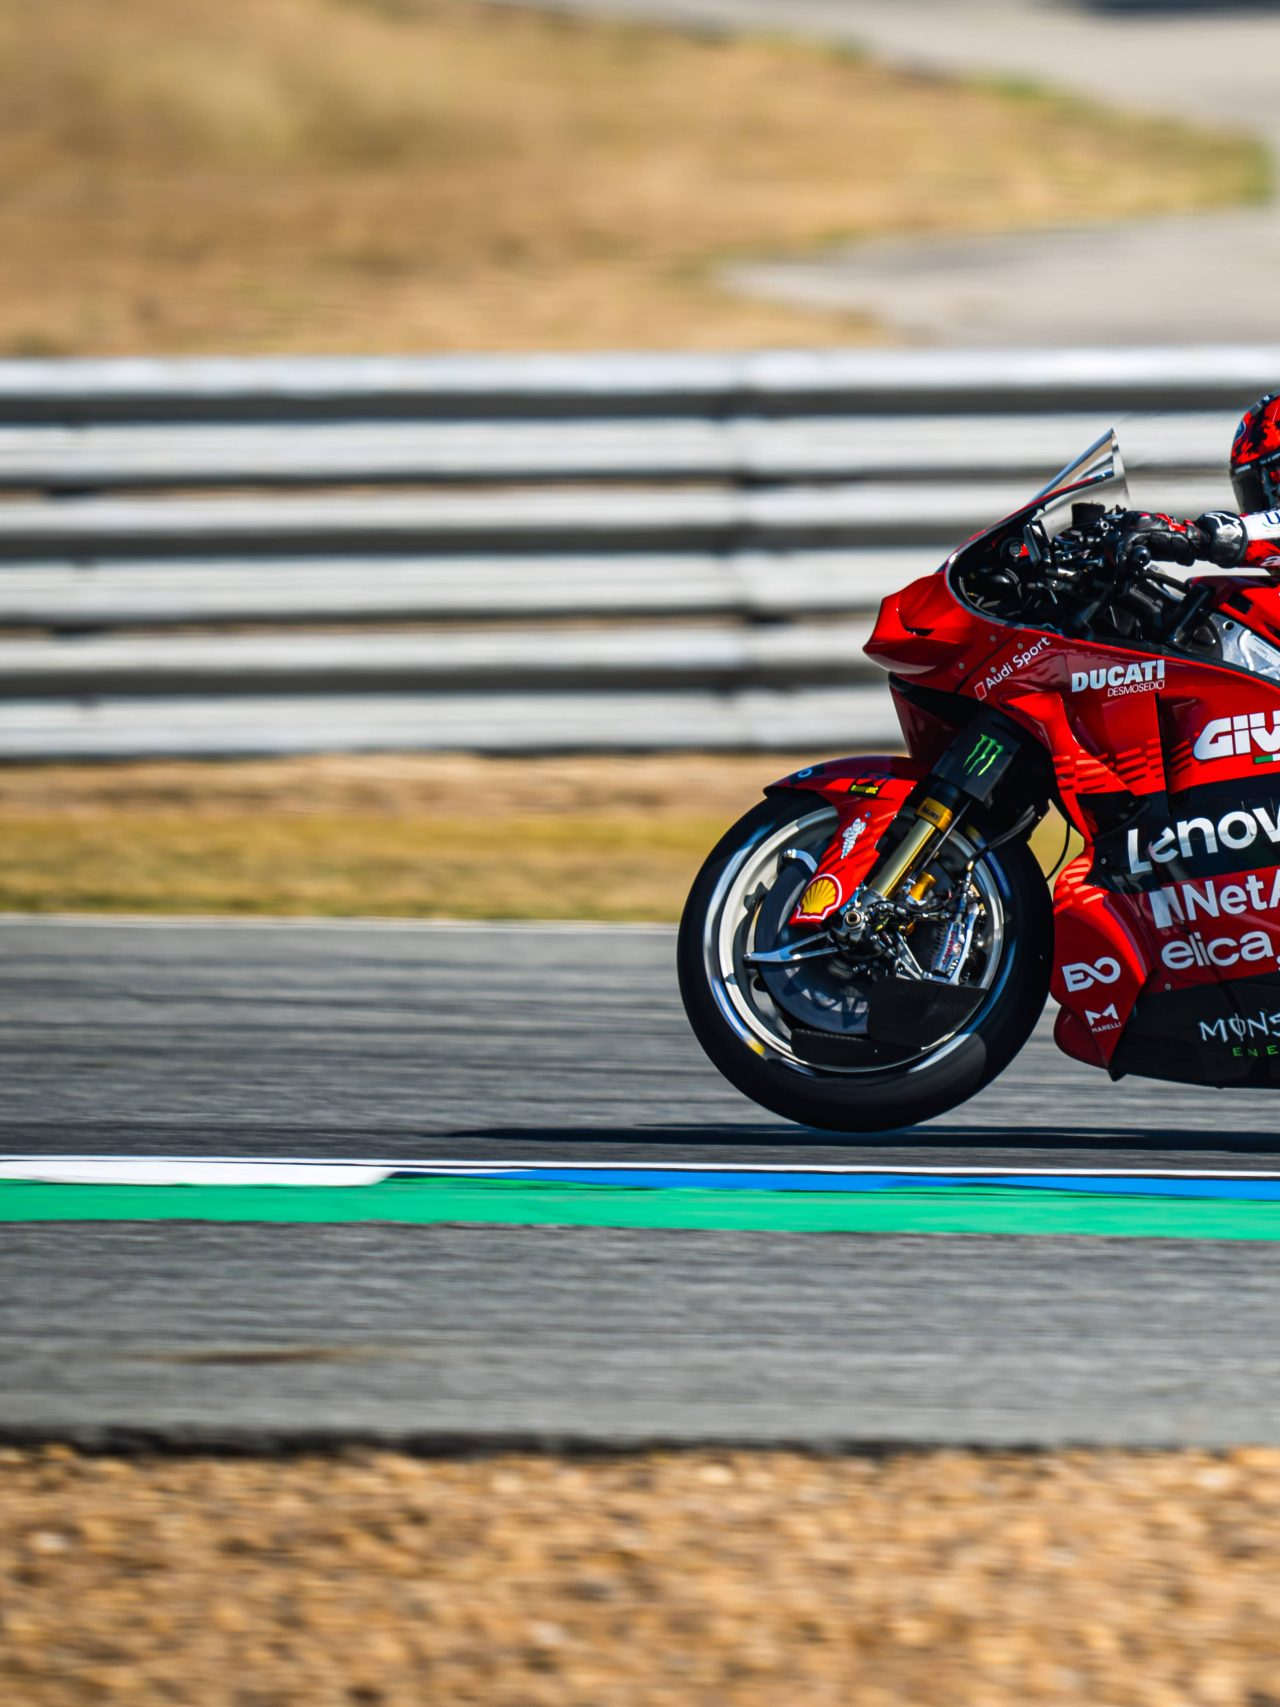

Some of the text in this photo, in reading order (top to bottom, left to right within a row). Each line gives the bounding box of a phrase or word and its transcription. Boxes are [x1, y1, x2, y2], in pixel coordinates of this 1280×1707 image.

[983, 636, 1052, 690] Audi Sport
[1071, 659, 1166, 693] DUCATI
[1107, 680, 1166, 698] DESMOSEDICI
[1160, 931, 1274, 970] elica
[1091, 1020, 1122, 1034] MARELLI
